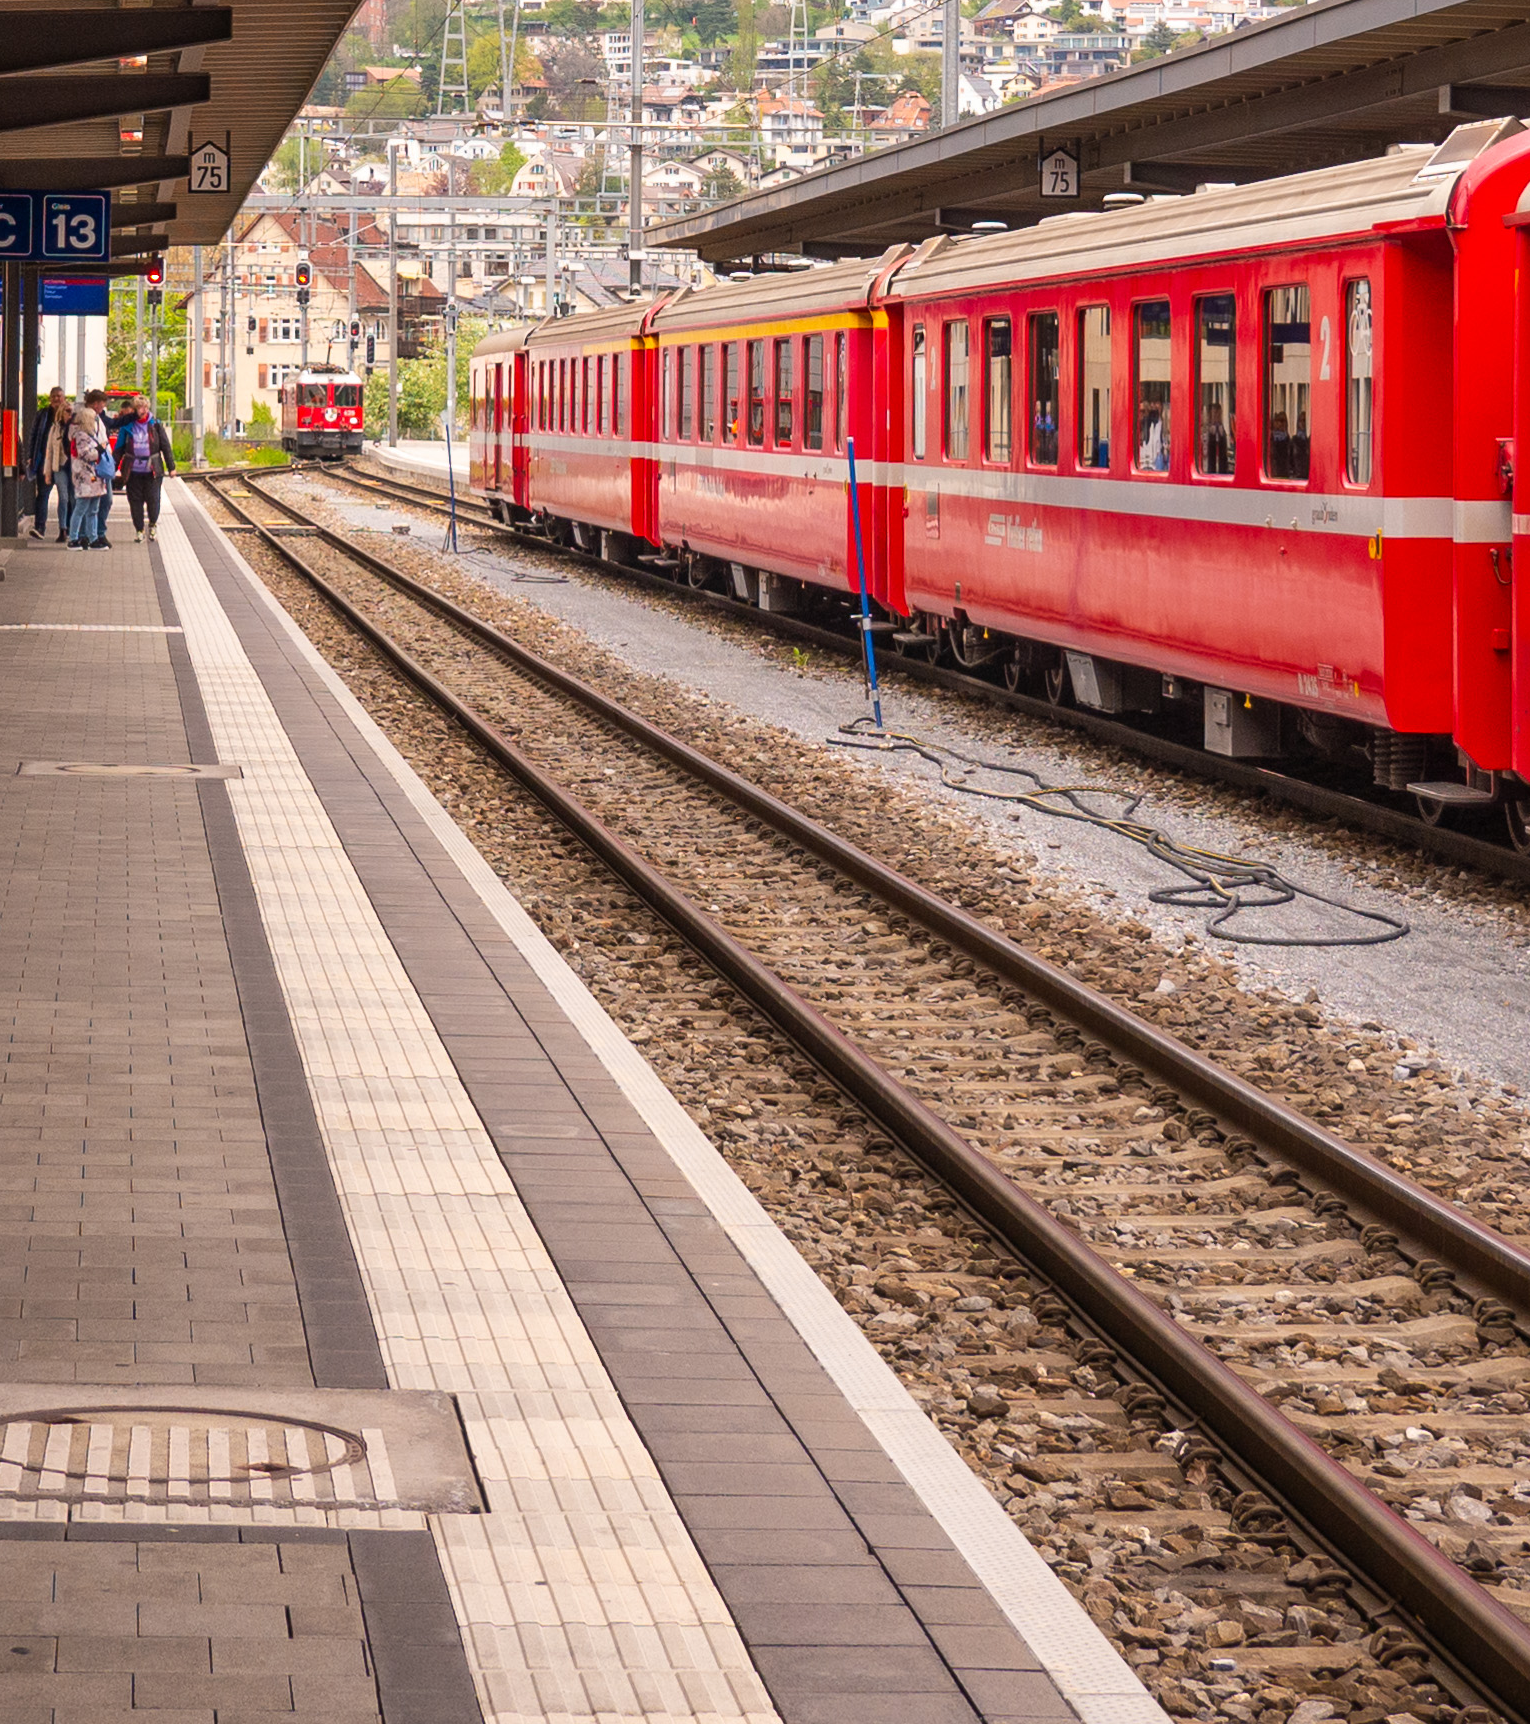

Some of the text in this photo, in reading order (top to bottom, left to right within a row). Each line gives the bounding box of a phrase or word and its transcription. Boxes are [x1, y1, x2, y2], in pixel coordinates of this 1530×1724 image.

[203, 152, 216, 164] m
[1054, 158, 1065, 169] m
[196, 166, 222, 188] 75
[1049, 171, 1069, 193] 75
[52, 214, 96, 249] 13
[1319, 315, 1331, 381] 2
